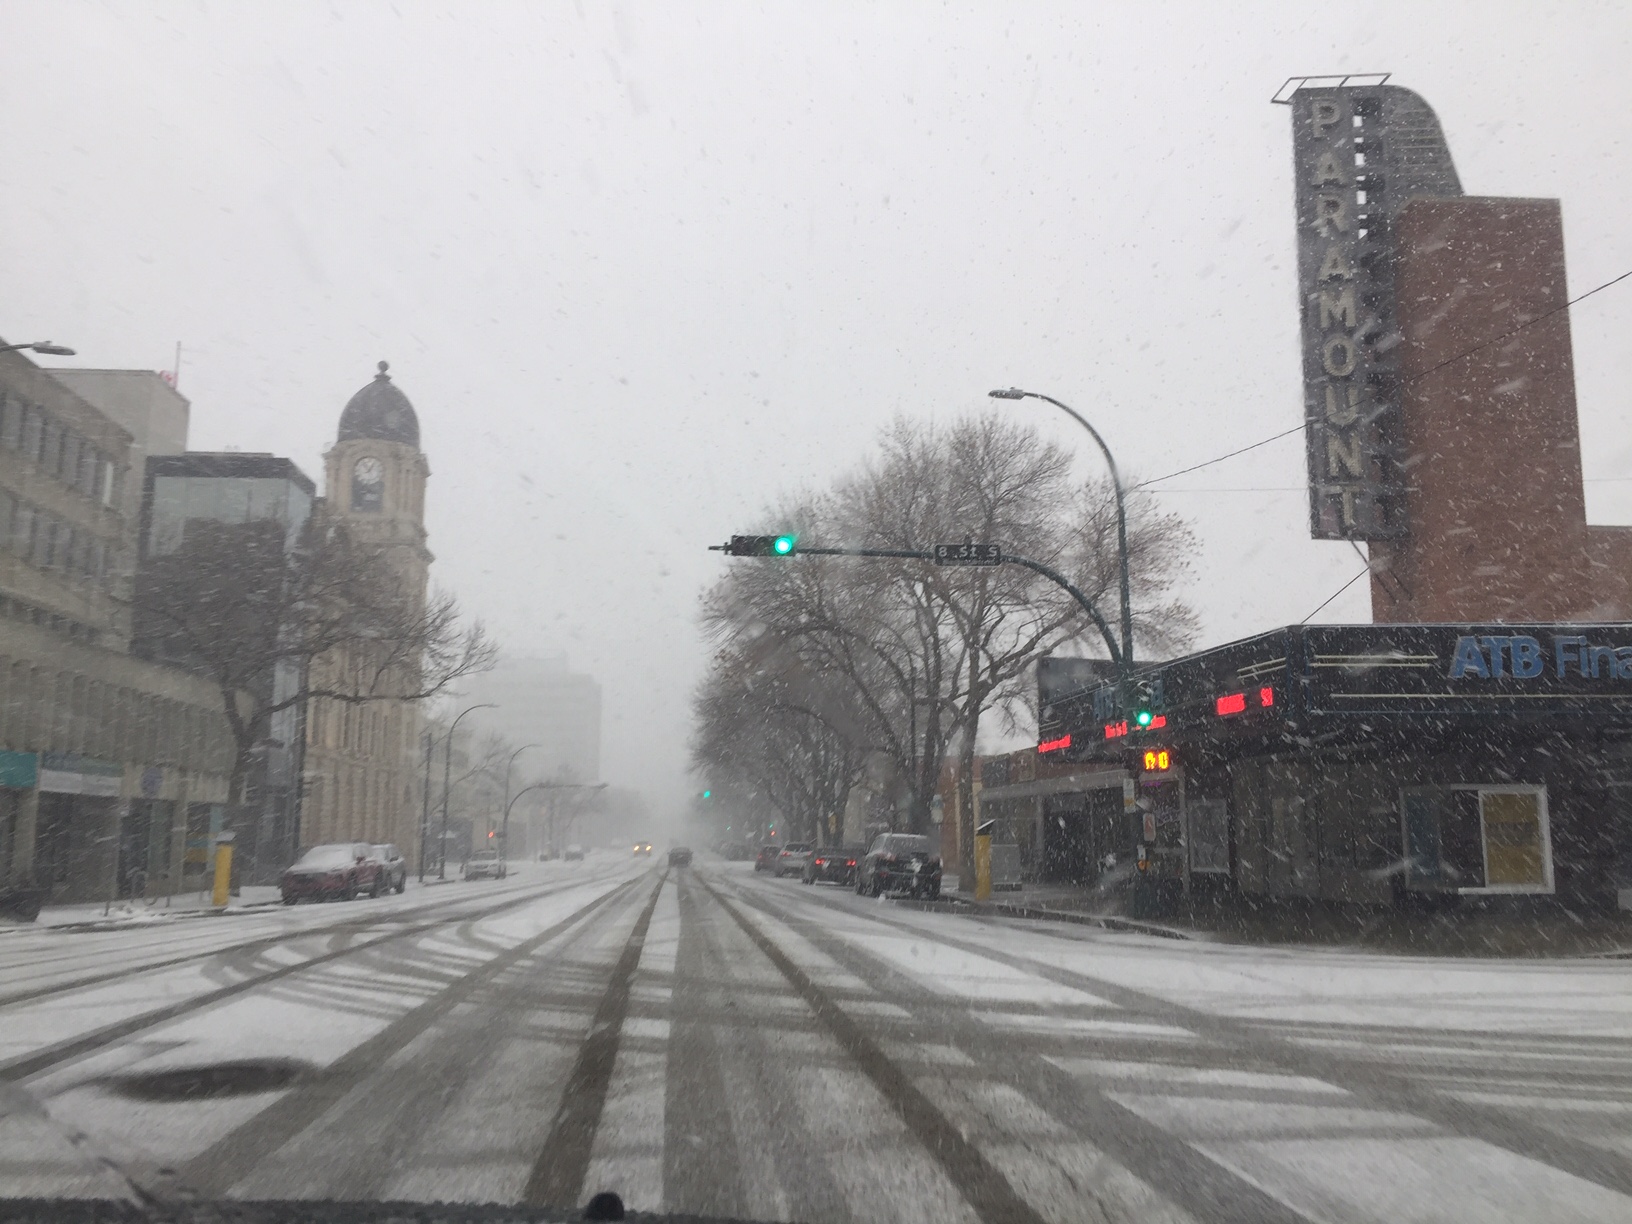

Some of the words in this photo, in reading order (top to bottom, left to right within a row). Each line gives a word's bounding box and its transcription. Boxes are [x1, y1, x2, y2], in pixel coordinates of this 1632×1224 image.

[1311, 96, 1362, 527] PARAMOUNT
[938, 546, 948, 557] 8
[1450, 635, 1544, 679] ATB
